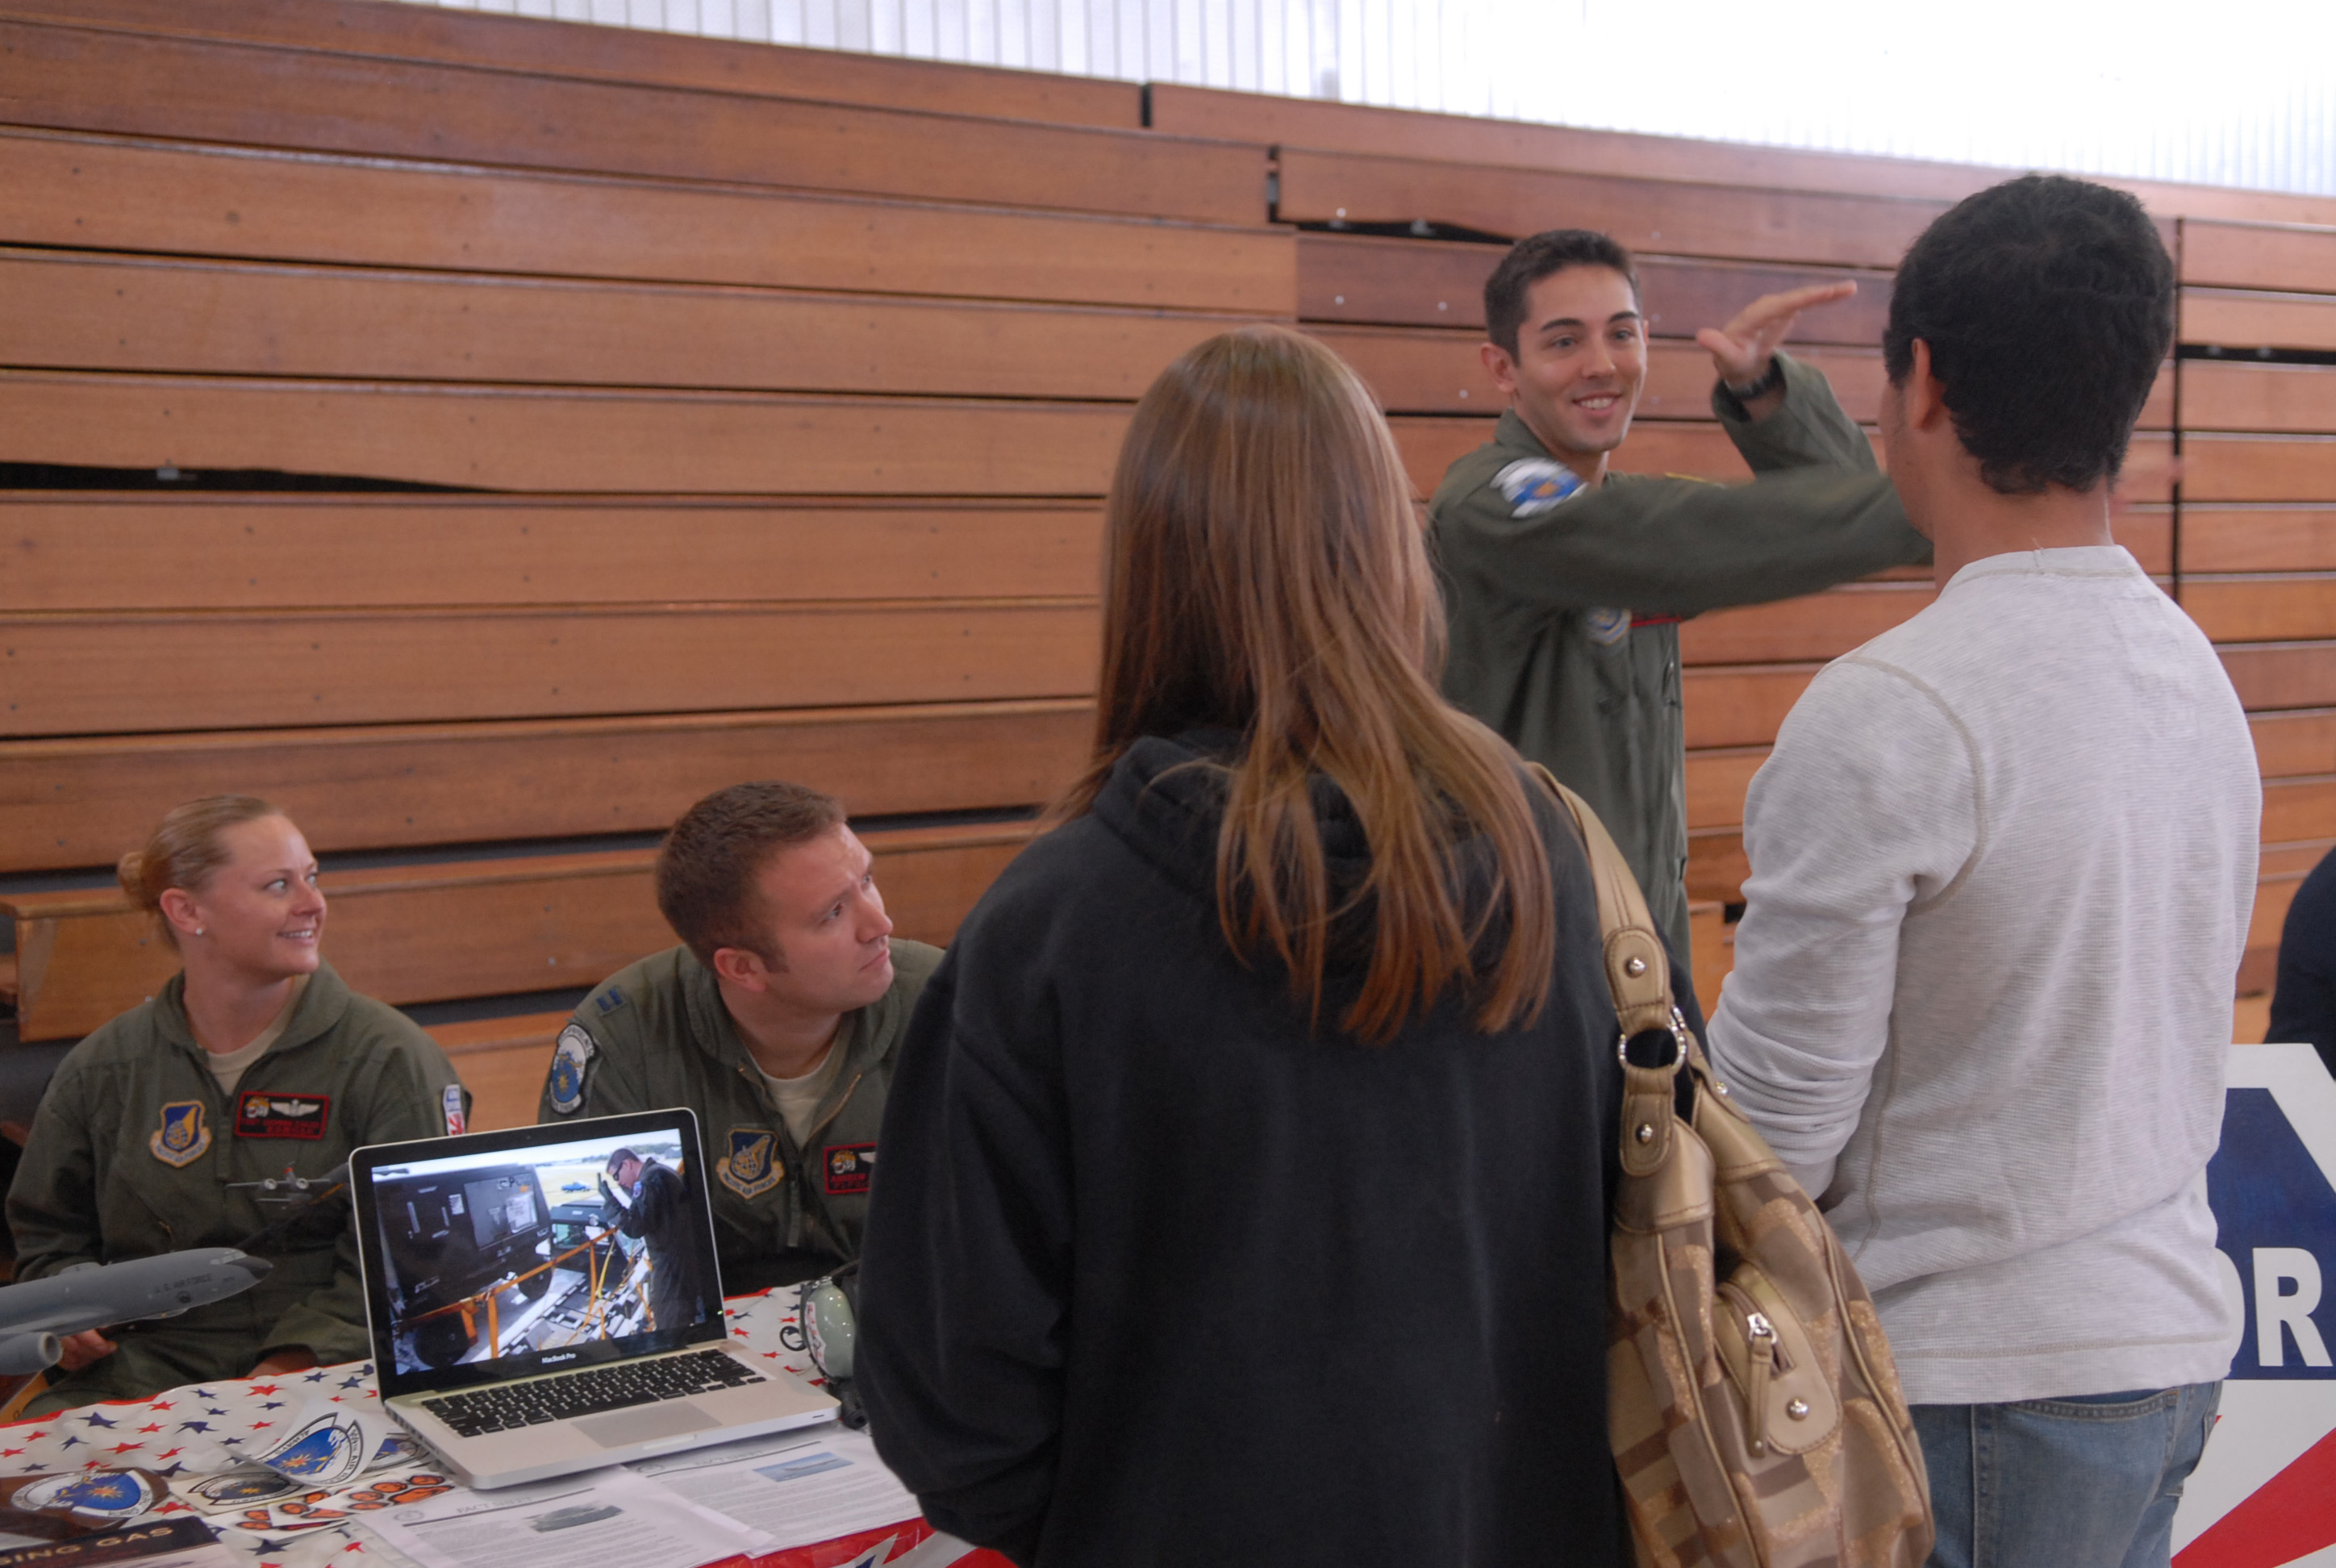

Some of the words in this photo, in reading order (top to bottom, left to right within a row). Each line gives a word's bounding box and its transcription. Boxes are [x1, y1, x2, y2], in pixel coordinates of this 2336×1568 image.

[541, 1353, 565, 1363] MacBook
[347, 1455, 358, 1470] AIR
[96, 1526, 174, 1547] GAS
